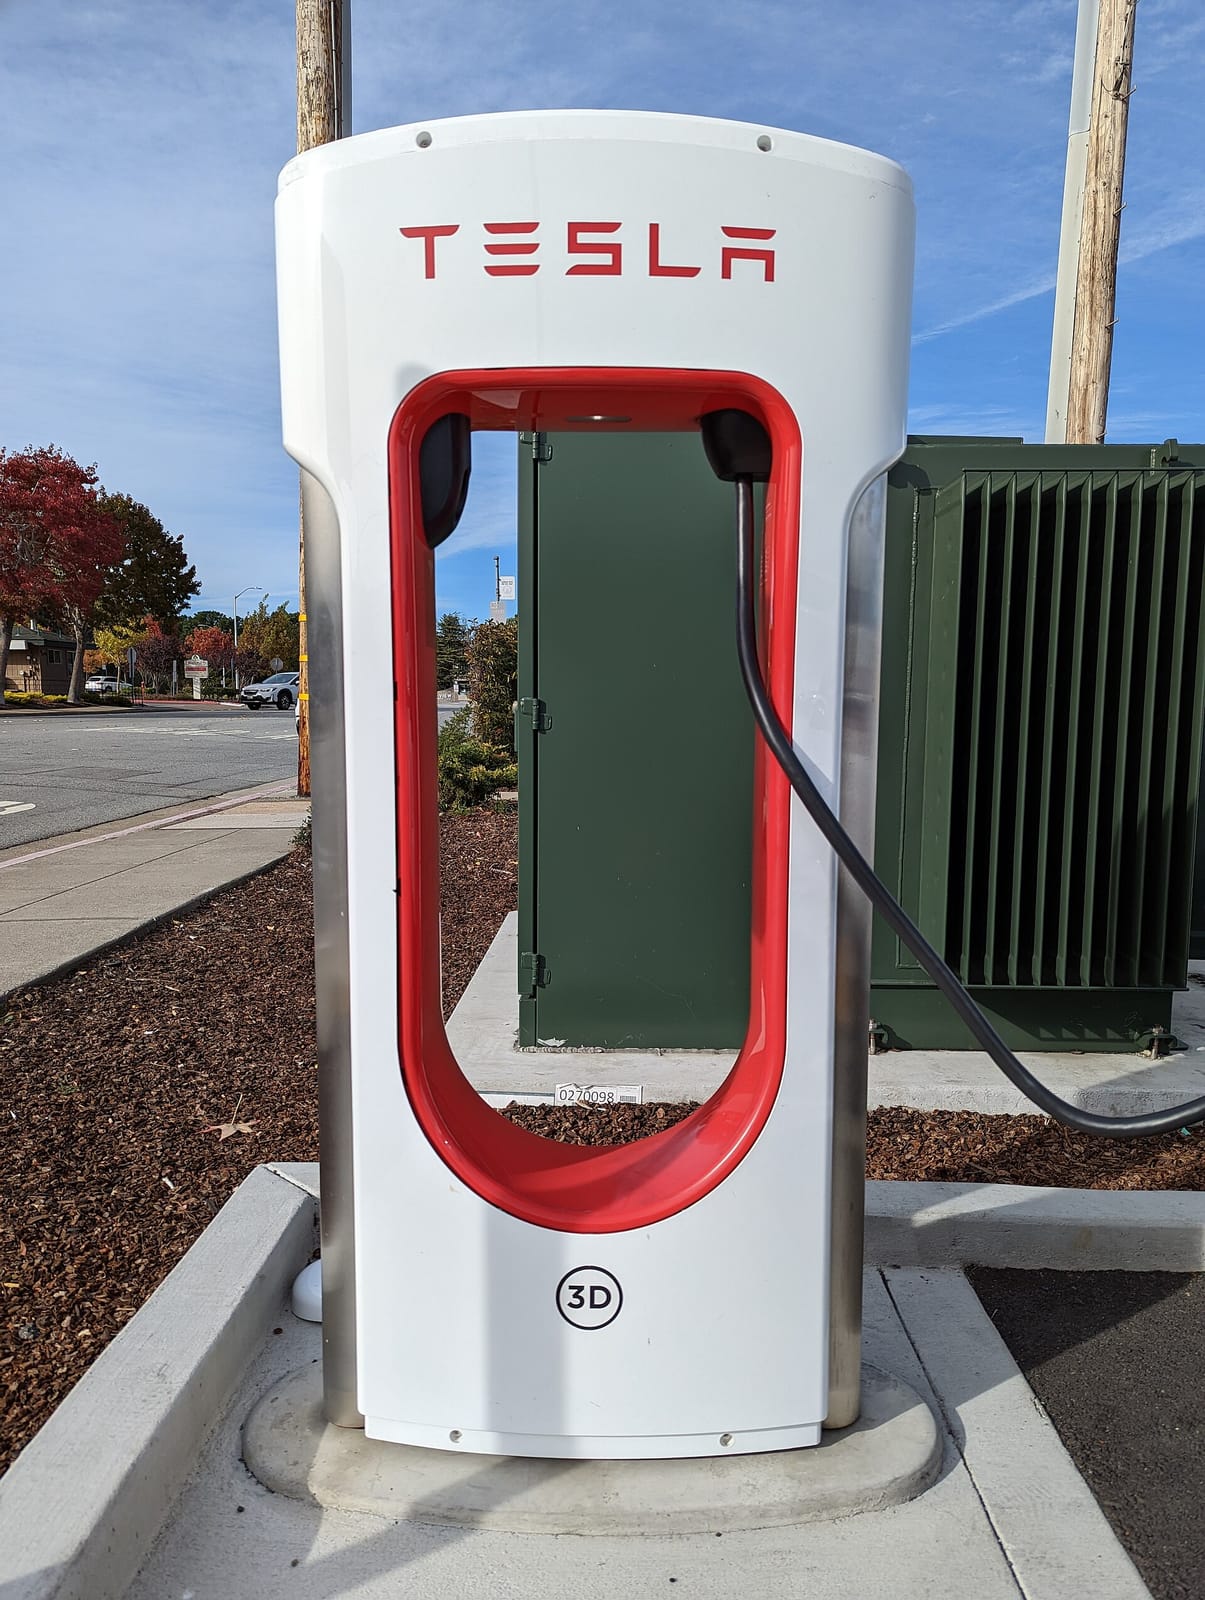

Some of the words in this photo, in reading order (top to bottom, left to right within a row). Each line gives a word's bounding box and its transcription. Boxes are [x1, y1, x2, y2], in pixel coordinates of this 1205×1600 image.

[400, 222, 776, 282] TESLA
[559, 1089, 615, 1103] 0270098
[567, 1285, 611, 1309] 3D
